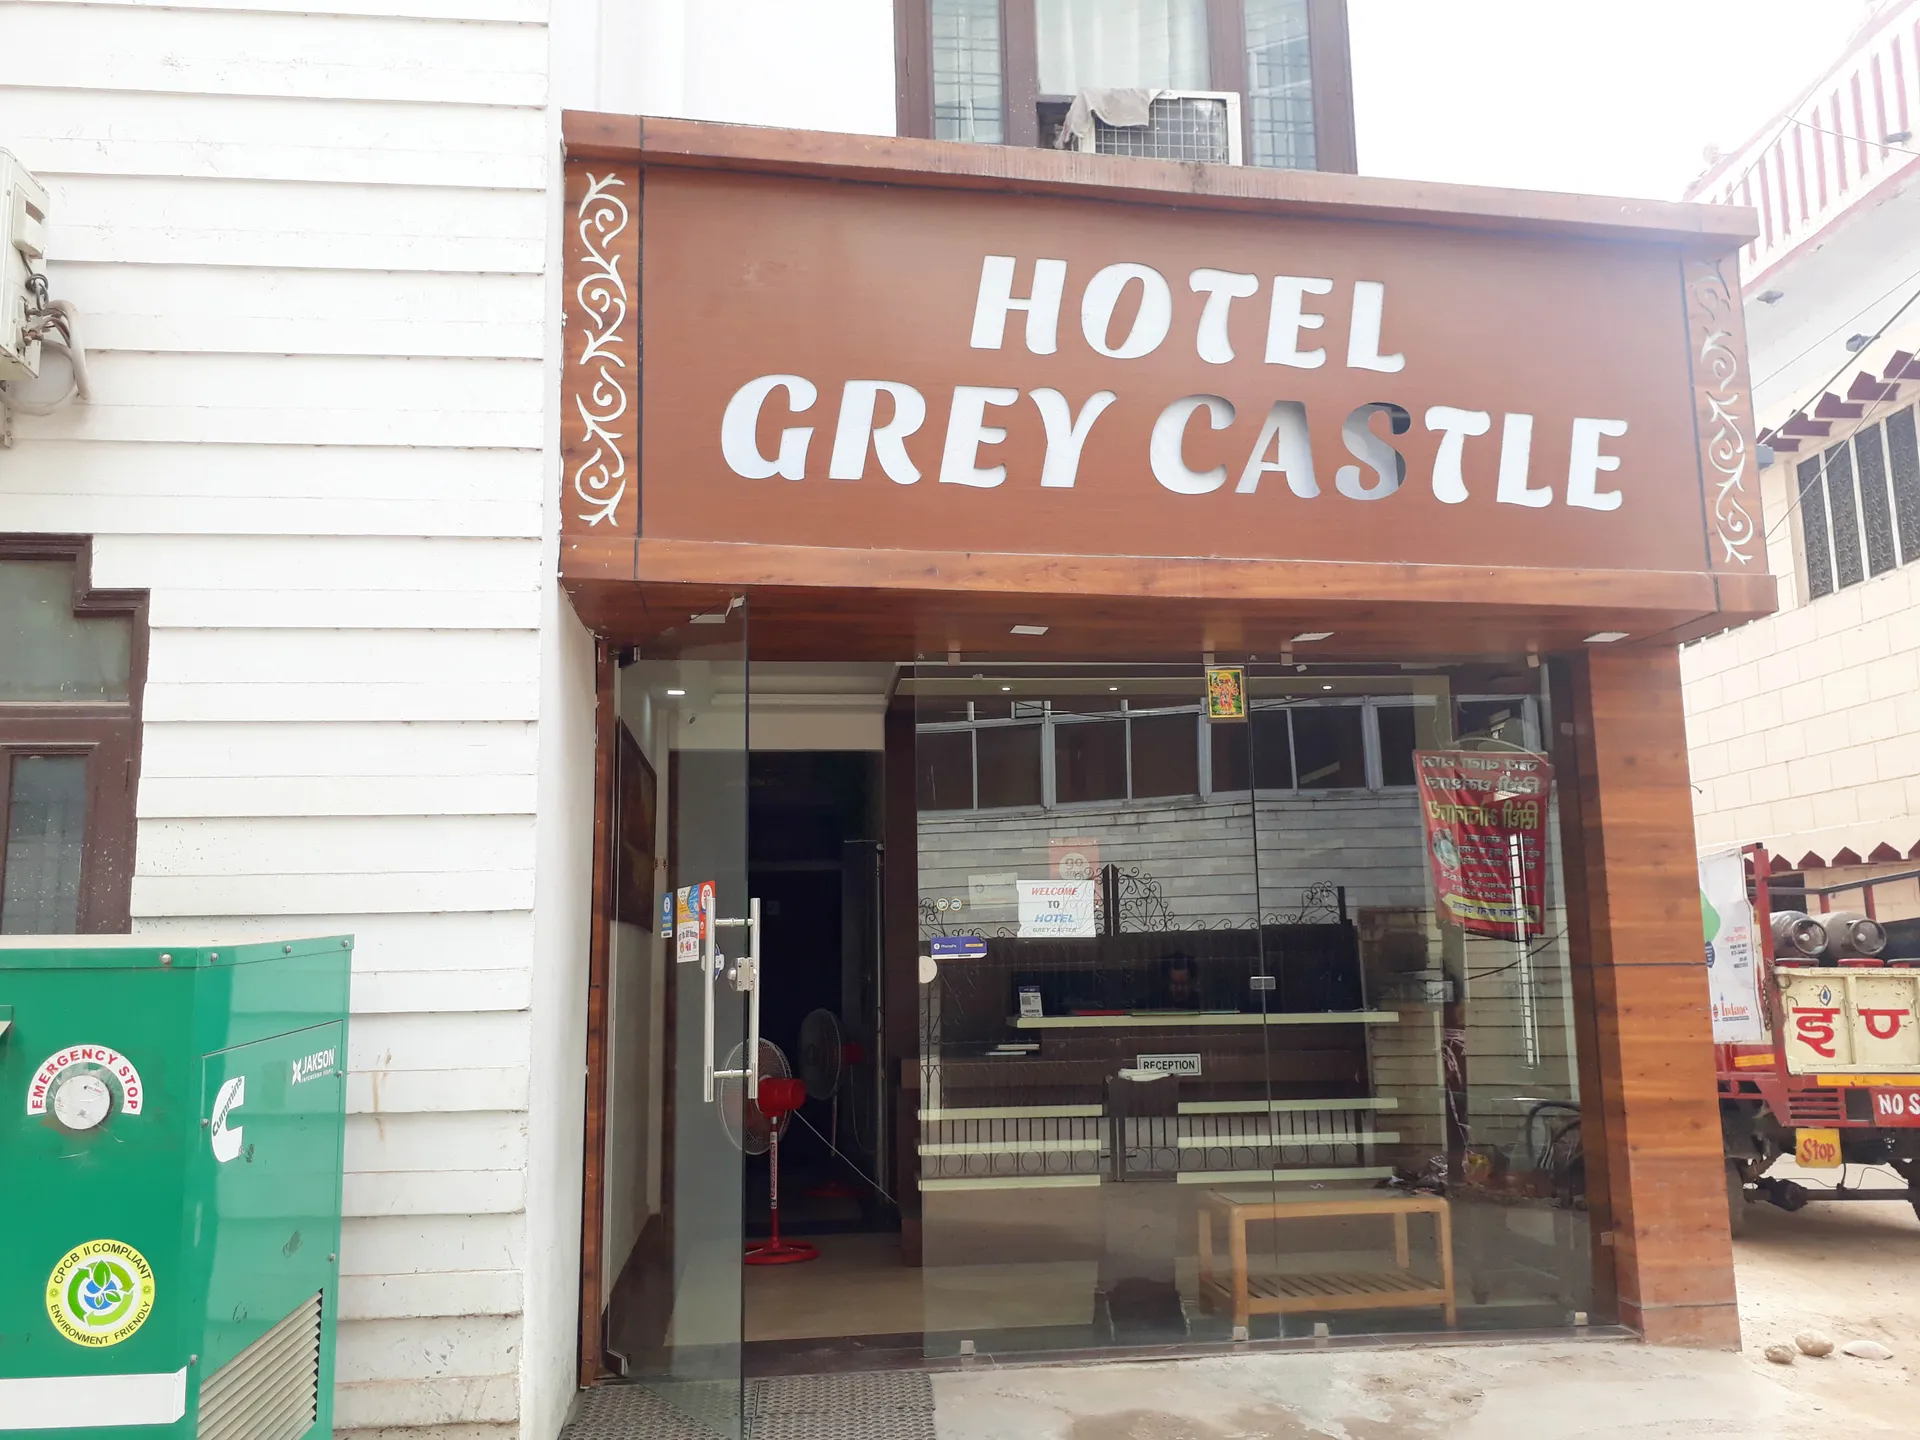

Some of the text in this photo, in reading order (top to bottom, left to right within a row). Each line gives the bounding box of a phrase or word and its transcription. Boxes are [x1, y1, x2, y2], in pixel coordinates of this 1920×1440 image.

[970, 254, 1406, 373] HOTEL
[720, 373, 1629, 512] GREY CASTLE
[1031, 887, 1079, 896] WELCOME
[1047, 900, 1060, 909] TO
[1034, 914, 1075, 924] HOTEL
[302, 1048, 335, 1074] JAKSON
[1143, 1060, 1195, 1070] RECEPTION
[32, 1048, 138, 1109] EMERGENCY STOP
[212, 1076, 243, 1137] Cummins
[1878, 1093, 1905, 1115] NO
[1801, 1138, 1836, 1164] Stop
[53, 1242, 152, 1284] CPCB II COMPLIANT
[50, 1301, 151, 1345] ENVIRONMENT FRIENDLY
